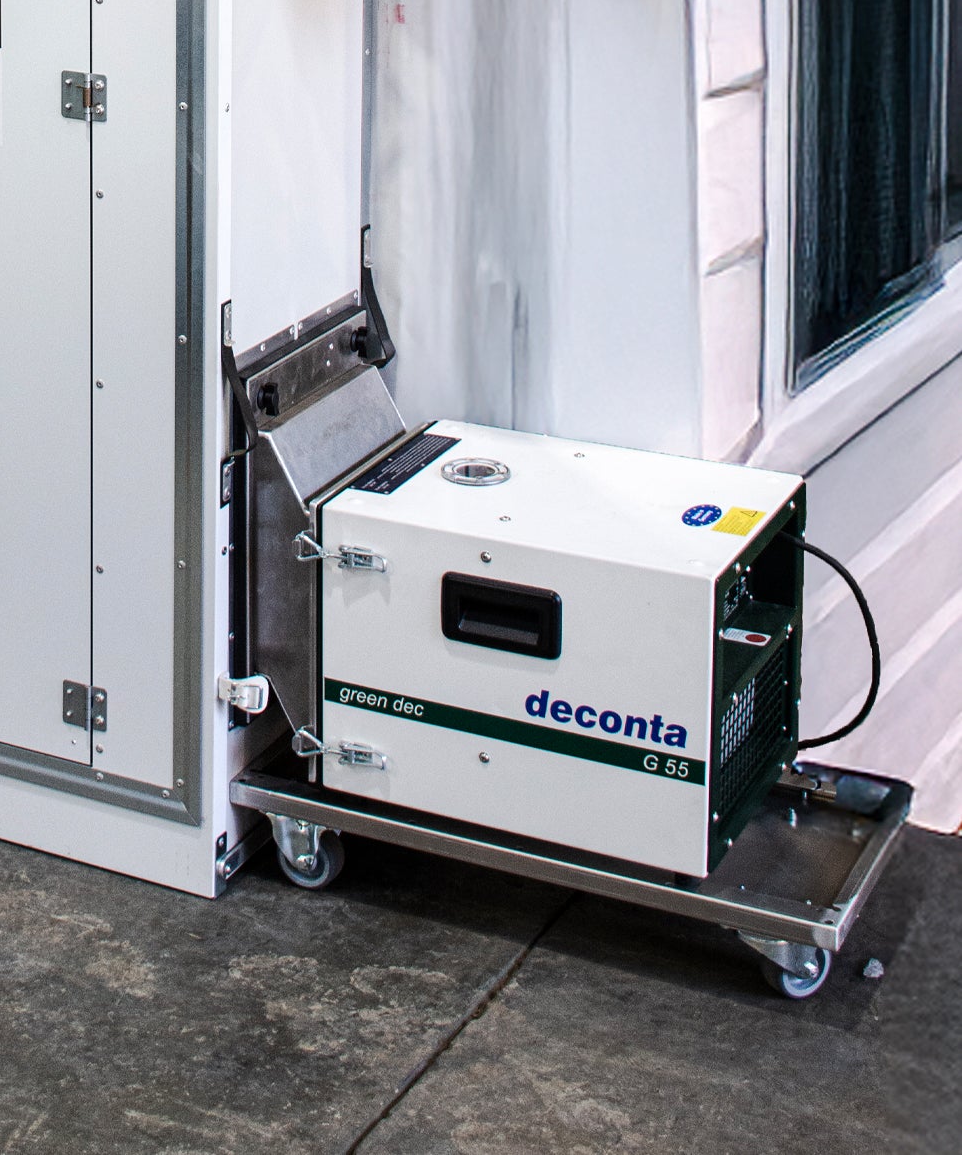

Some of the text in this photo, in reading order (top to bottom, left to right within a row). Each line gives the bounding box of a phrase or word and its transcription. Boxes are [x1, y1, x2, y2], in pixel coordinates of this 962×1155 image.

[339, 686, 425, 717] green dec
[525, 689, 688, 748] deconta
[643, 753, 690, 777] G 55
